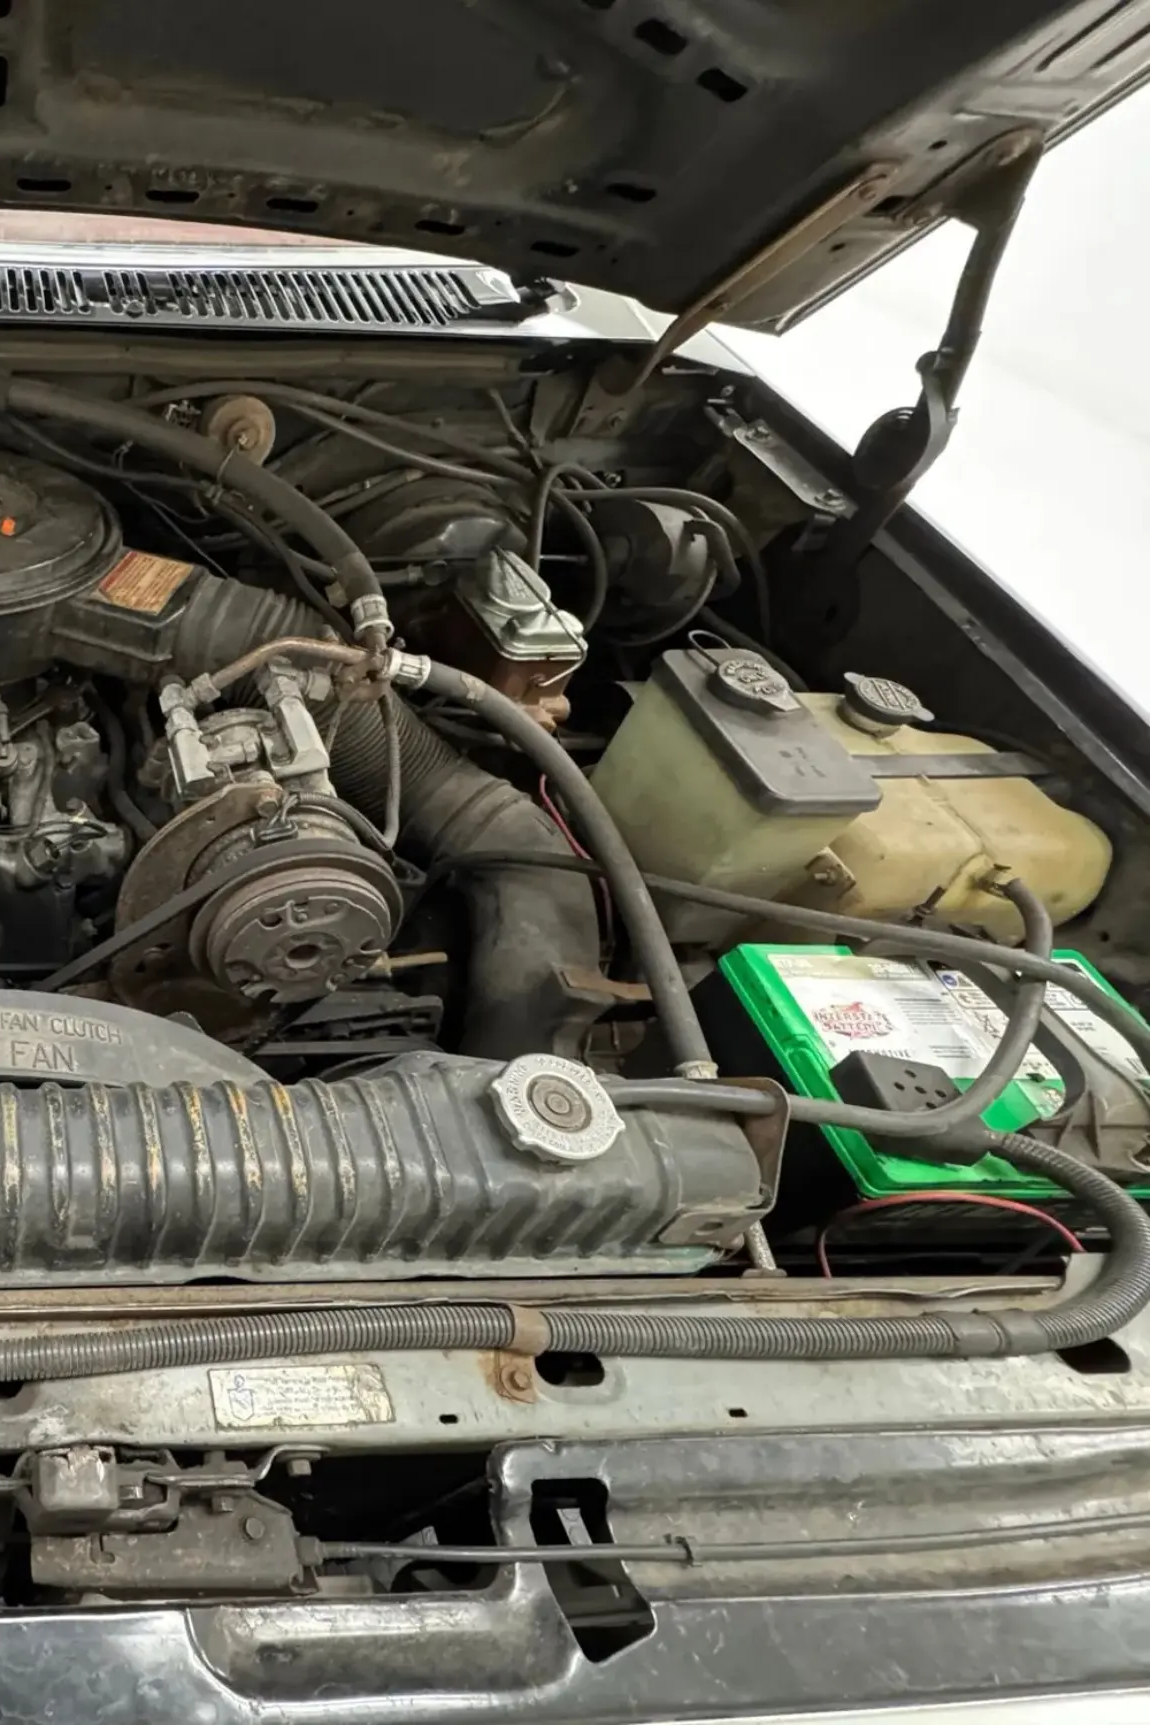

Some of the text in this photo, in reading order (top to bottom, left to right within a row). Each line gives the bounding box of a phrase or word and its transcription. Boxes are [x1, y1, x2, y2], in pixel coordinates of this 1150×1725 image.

[0, 1010, 40, 1032] FAN
[49, 1016, 122, 1046] CLUTCH
[10, 1039, 76, 1073] FAN
